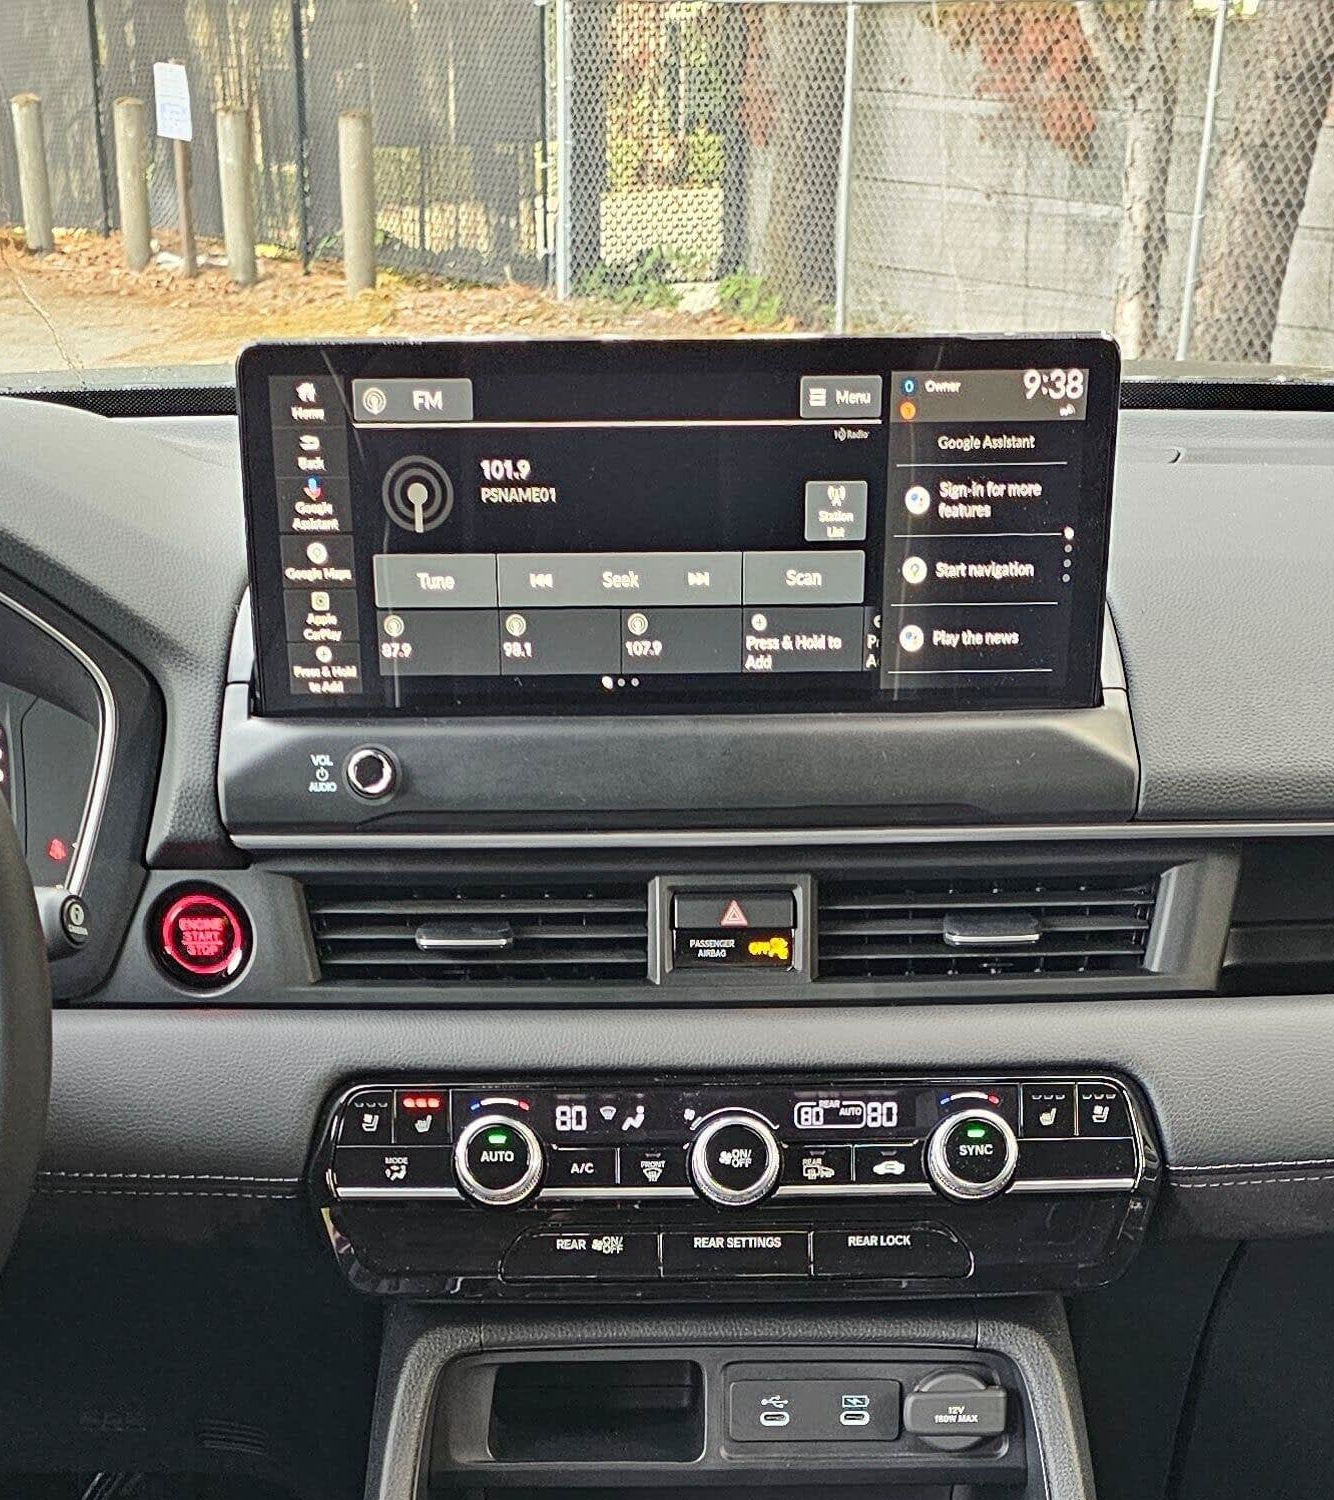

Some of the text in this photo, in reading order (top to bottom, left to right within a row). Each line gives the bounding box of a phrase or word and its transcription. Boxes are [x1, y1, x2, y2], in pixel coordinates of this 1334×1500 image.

[924, 380, 961, 393] Owner
[1023, 368, 1084, 400] 9:38
[412, 390, 443, 411] FM
[836, 389, 871, 406] Menu
[937, 434, 1036, 451] Google Assistant
[480, 459, 530, 481] 101.9
[481, 487, 556, 504] PSNAME01
[939, 481, 1043, 500] Sign-in for more
[295, 502, 333, 515] Google
[938, 502, 992, 519] features
[818, 510, 854, 522] Station
[292, 518, 340, 531] Assistant
[935, 560, 1035, 580] Start navigation
[417, 572, 455, 591] Tune
[602, 571, 639, 590] Seek
[785, 569, 822, 587] Scan
[745, 634, 842, 651] Press & Hold to
[932, 629, 1020, 648] Play the news
[382, 642, 412, 659] 87.9
[503, 641, 532, 658] 98.1
[625, 641, 662, 657] 107.9
[744, 654, 773, 670] Add
[310, 754, 333, 767] VOL
[308, 781, 337, 793] AUDIO
[182, 931, 221, 942] START
[689, 938, 735, 948] PASSENGER
[697, 949, 727, 958] AIRBAG
[819, 1100, 840, 1108] REAR
[555, 1105, 587, 1131] 80
[800, 1106, 824, 1126] 80
[839, 1107, 862, 1116] AUTO
[866, 1102, 897, 1127] 80
[480, 1150, 514, 1162] AUTO
[959, 1144, 993, 1157] SYNC
[385, 1156, 408, 1164] MODE
[640, 1160, 665, 1168] FRONT
[731, 1158, 752, 1168] OFF
[802, 1158, 822, 1166] REAR
[570, 1162, 594, 1174] A/C
[556, 1239, 586, 1250] REAR
[694, 1236, 782, 1249] REAR SETTINGS
[848, 1235, 911, 1247] REAR LOCK
[602, 1244, 623, 1254] OFF
[948, 1406, 965, 1415] 12V
[957, 1414, 978, 1423] MAX
